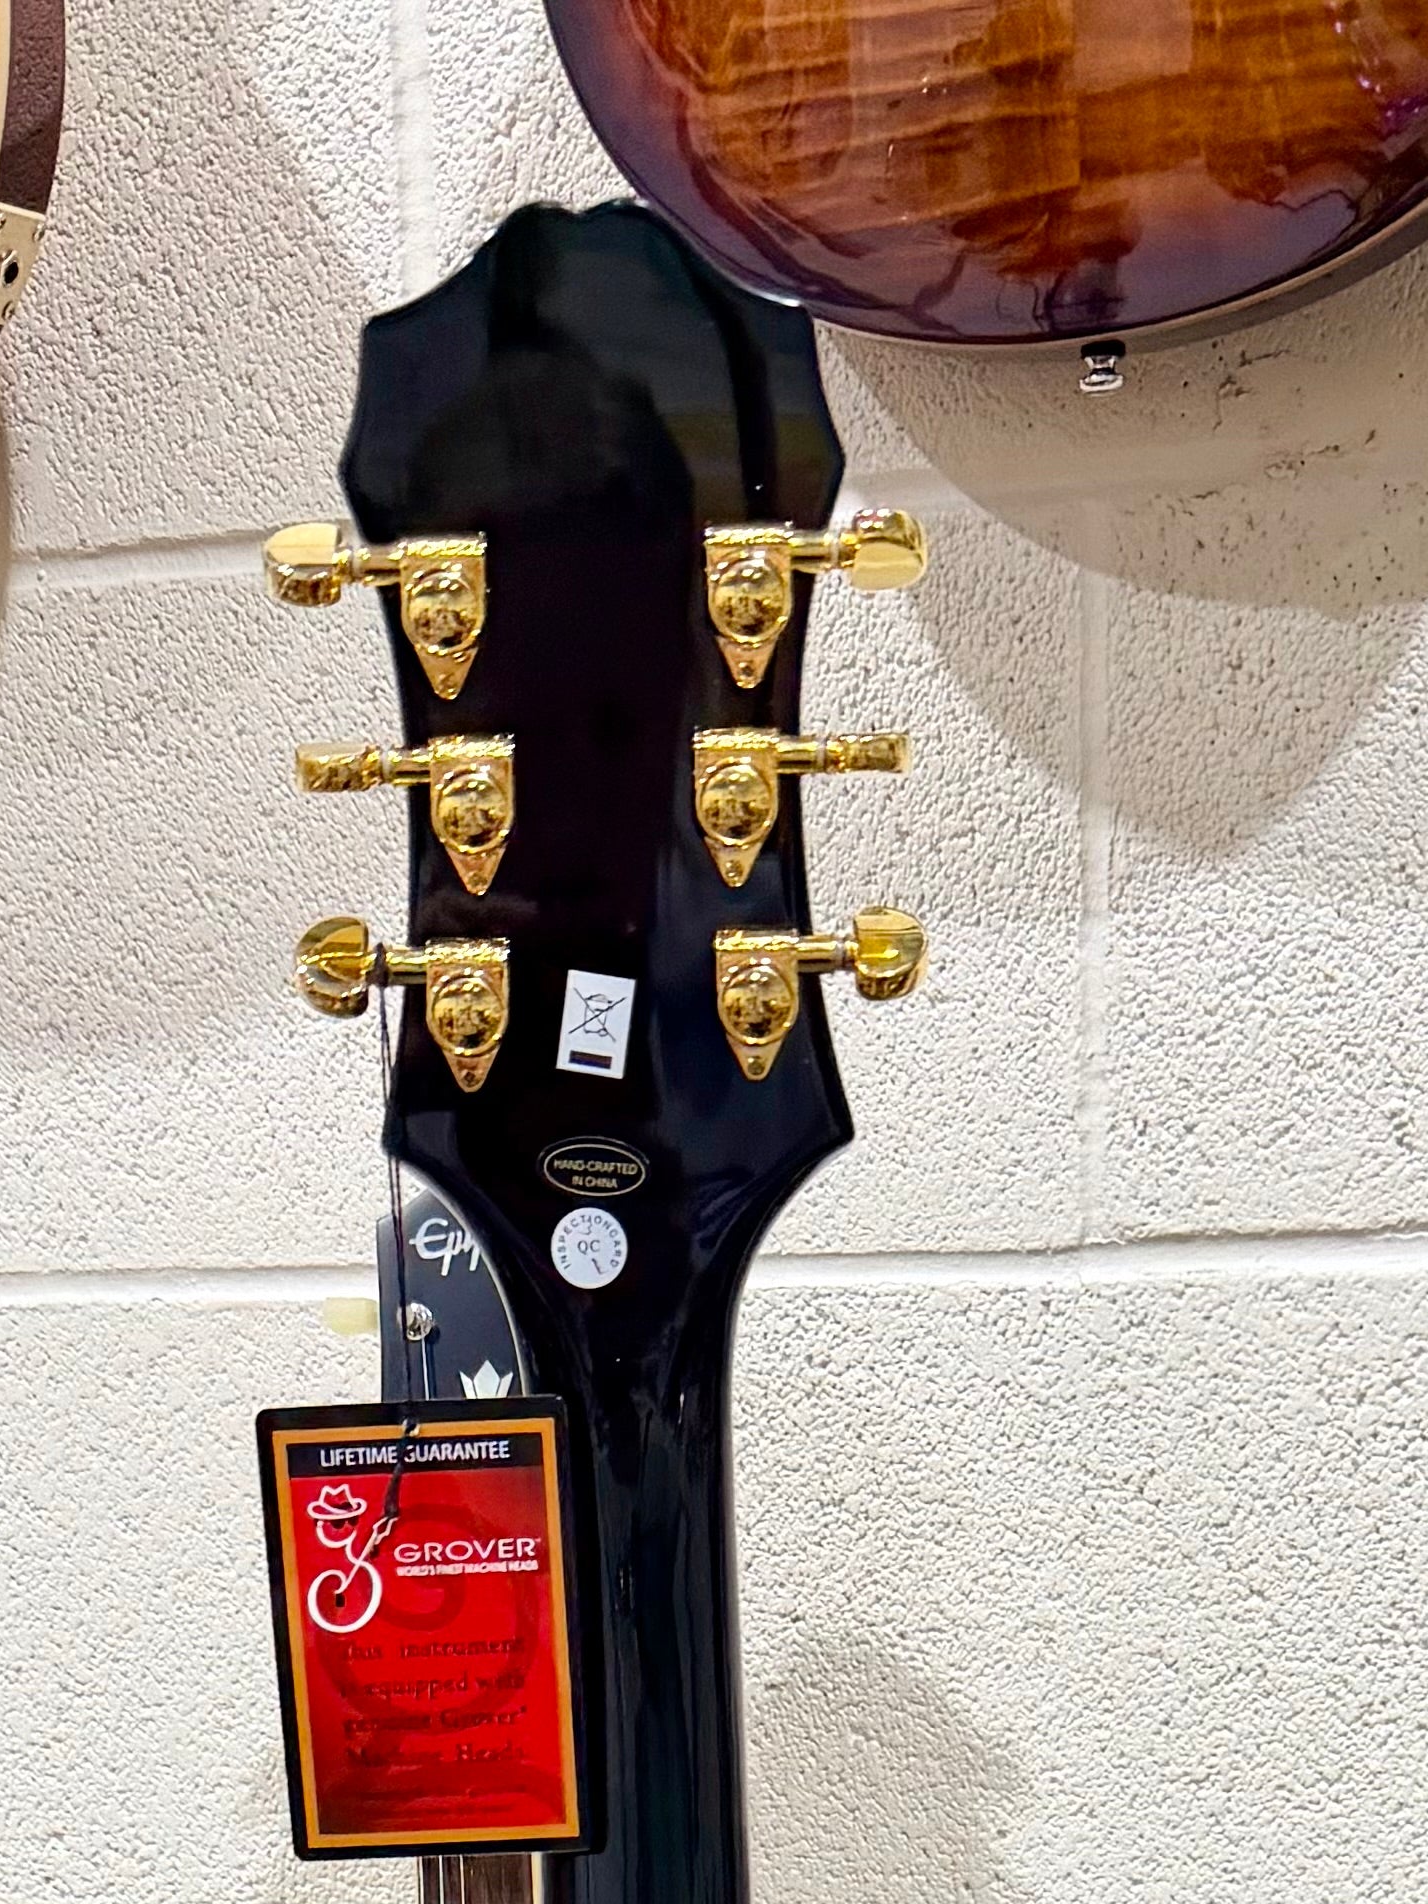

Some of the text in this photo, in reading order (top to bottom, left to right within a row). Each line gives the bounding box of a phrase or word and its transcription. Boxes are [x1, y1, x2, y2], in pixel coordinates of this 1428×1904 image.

[577, 1240, 600, 1255] QC
[320, 1441, 510, 1467] LIFETIME GUARANTEE
[393, 1538, 536, 1563] GROVER
